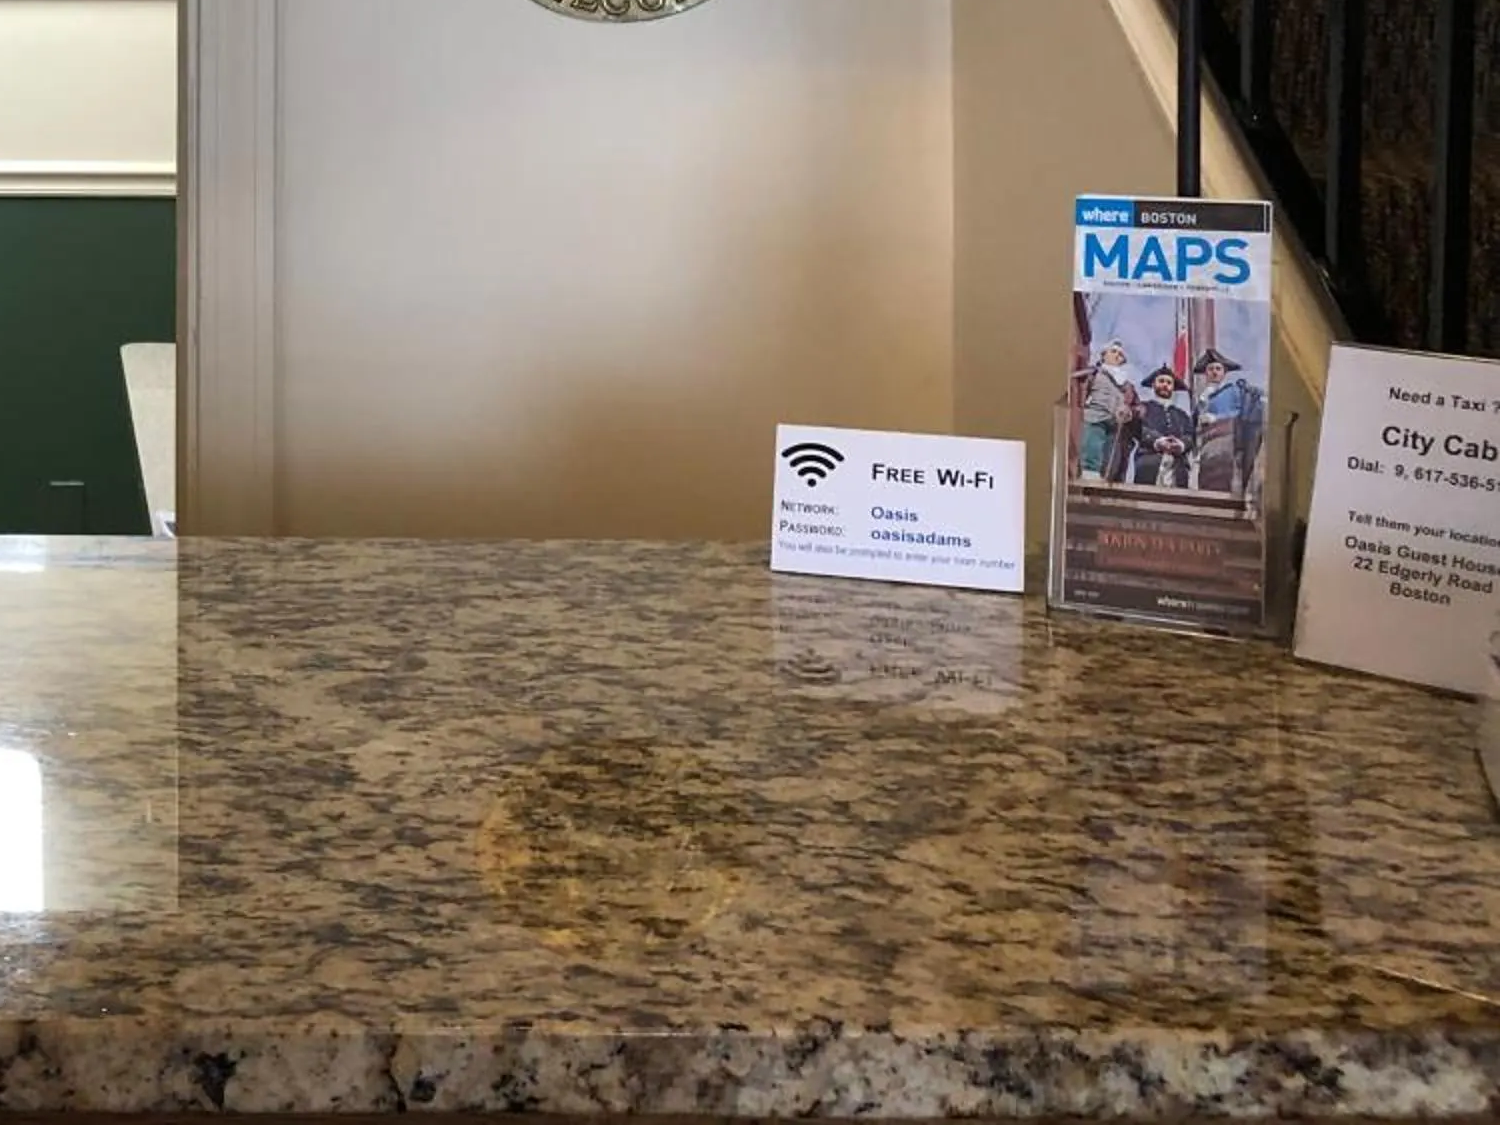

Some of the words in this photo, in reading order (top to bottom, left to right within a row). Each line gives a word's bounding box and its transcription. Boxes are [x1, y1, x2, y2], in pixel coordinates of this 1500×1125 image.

[1082, 206, 1129, 224] where
[1140, 212, 1198, 226] BOSTON
[1083, 231, 1252, 286] MAPS
[1389, 386, 1432, 405] Need
[1435, 395, 1445, 406] a
[1451, 394, 1485, 412] Taxi
[1382, 426, 1436, 456] City
[1443, 435, 1498, 462] Cab
[871, 462, 926, 484] FREE
[936, 468, 994, 490] WI-FI
[1347, 456, 1385, 474] Dial:
[870, 506, 919, 523] Oasis
[1348, 510, 1373, 526] Tell
[1375, 516, 1411, 532] them
[1413, 525, 1447, 537] your
[870, 528, 972, 548] oasisadams
[1345, 536, 1392, 556] Oasis
[1397, 545, 1447, 567] Guest
[1353, 556, 1373, 572] 22
[1378, 560, 1443, 588] Edgerly
[1447, 573, 1493, 594] Road
[1389, 581, 1452, 606] Boston
